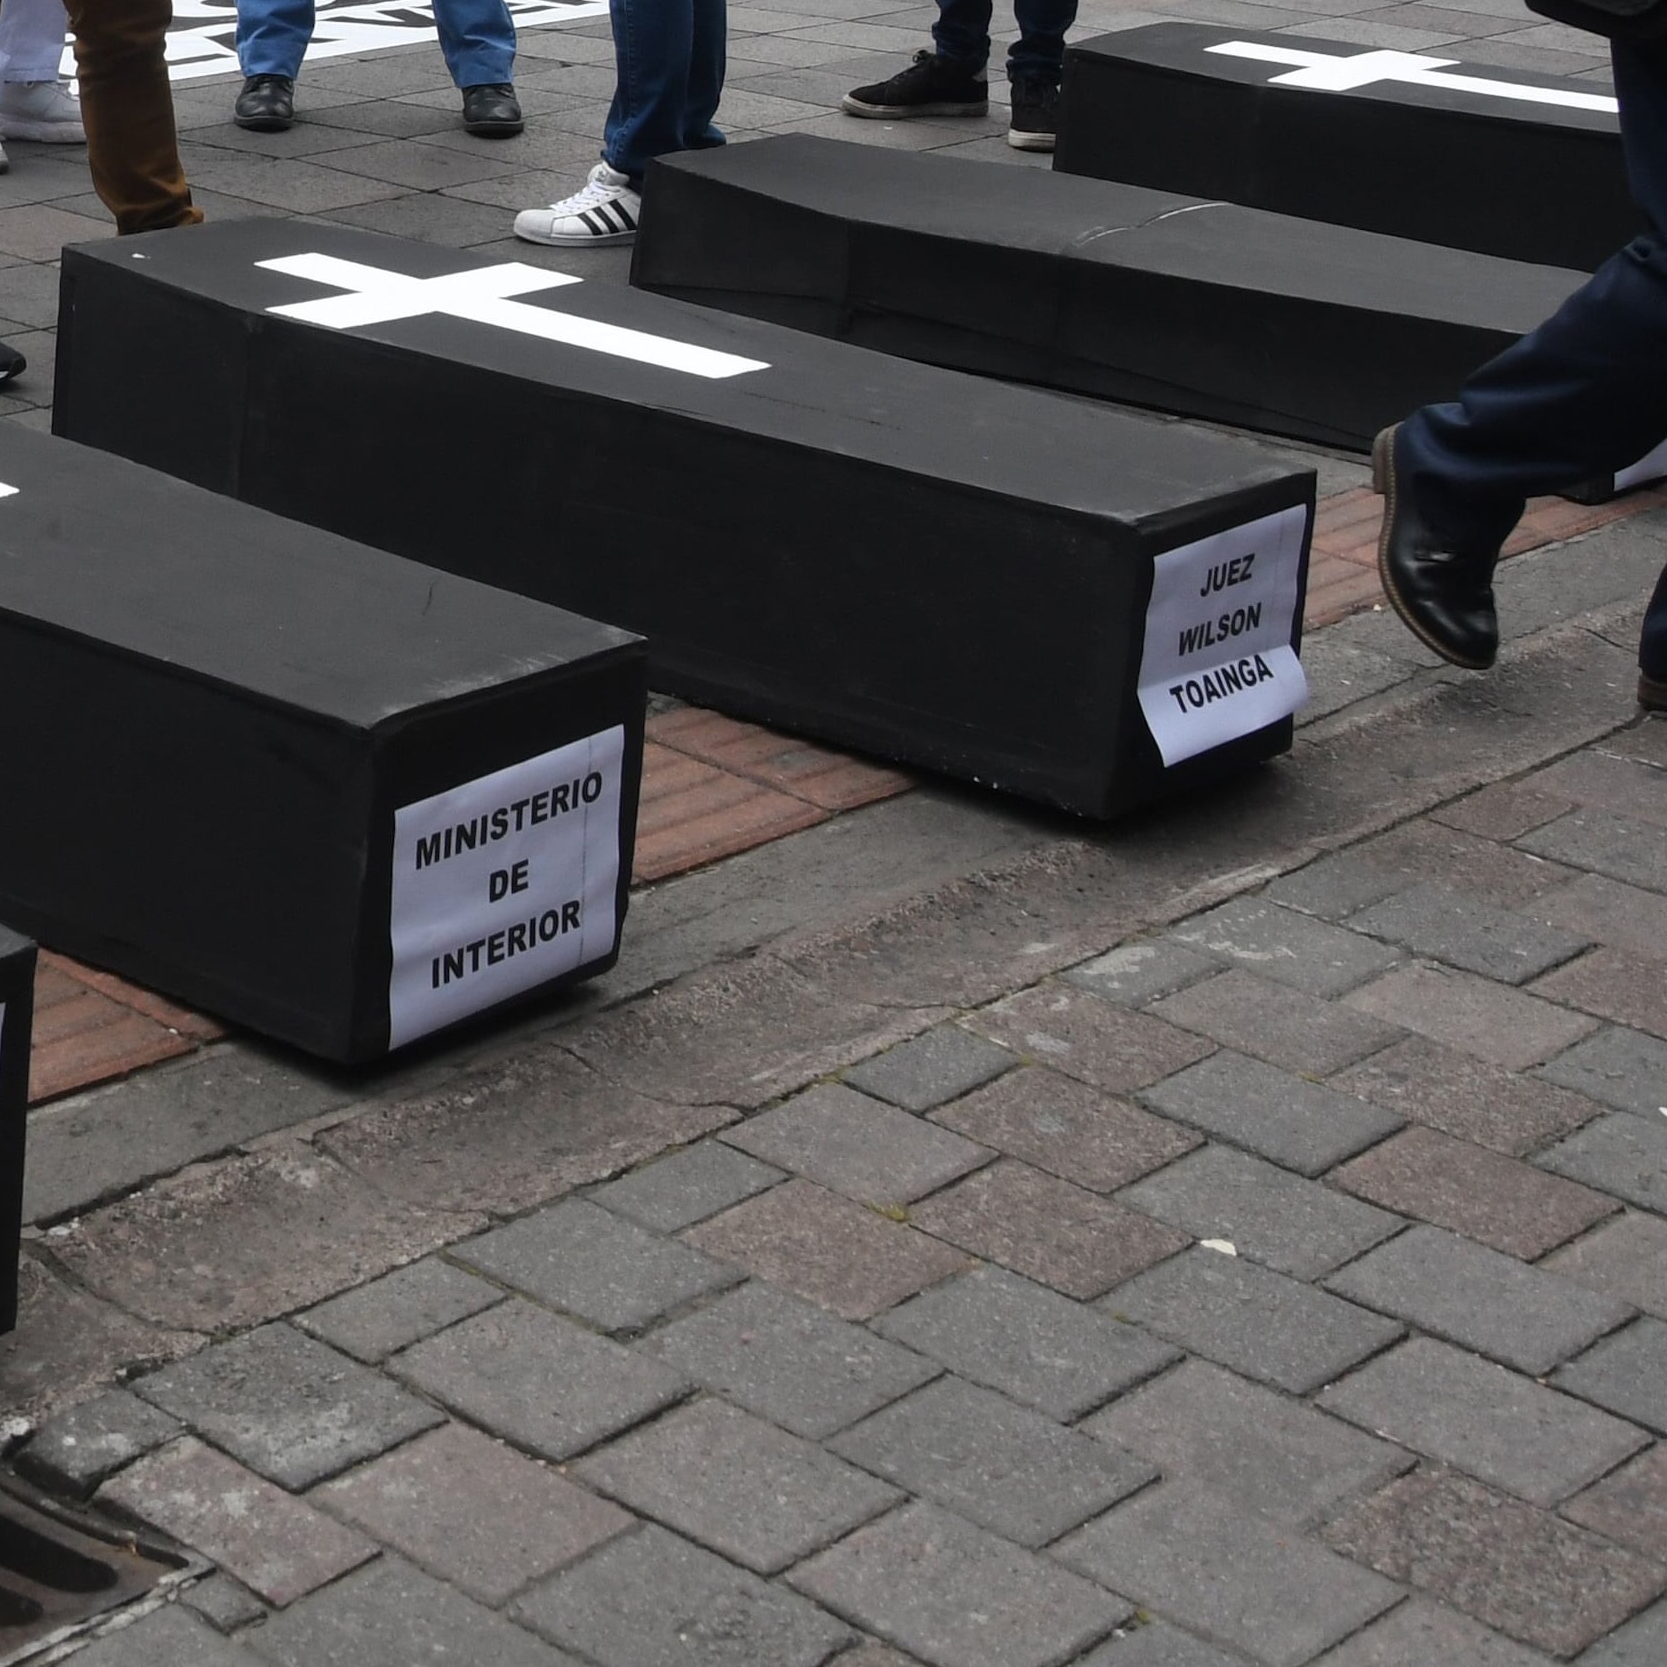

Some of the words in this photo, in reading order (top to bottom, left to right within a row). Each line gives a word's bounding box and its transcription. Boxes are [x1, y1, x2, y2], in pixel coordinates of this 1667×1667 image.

[1199, 552, 1254, 598] JUEZ
[1176, 602, 1263, 658] WILSON
[1168, 654, 1274, 716] TOAINGA
[414, 770, 604, 873] MINISTERIO
[488, 859, 531, 905] DE
[430, 897, 582, 990] INTERIOR
